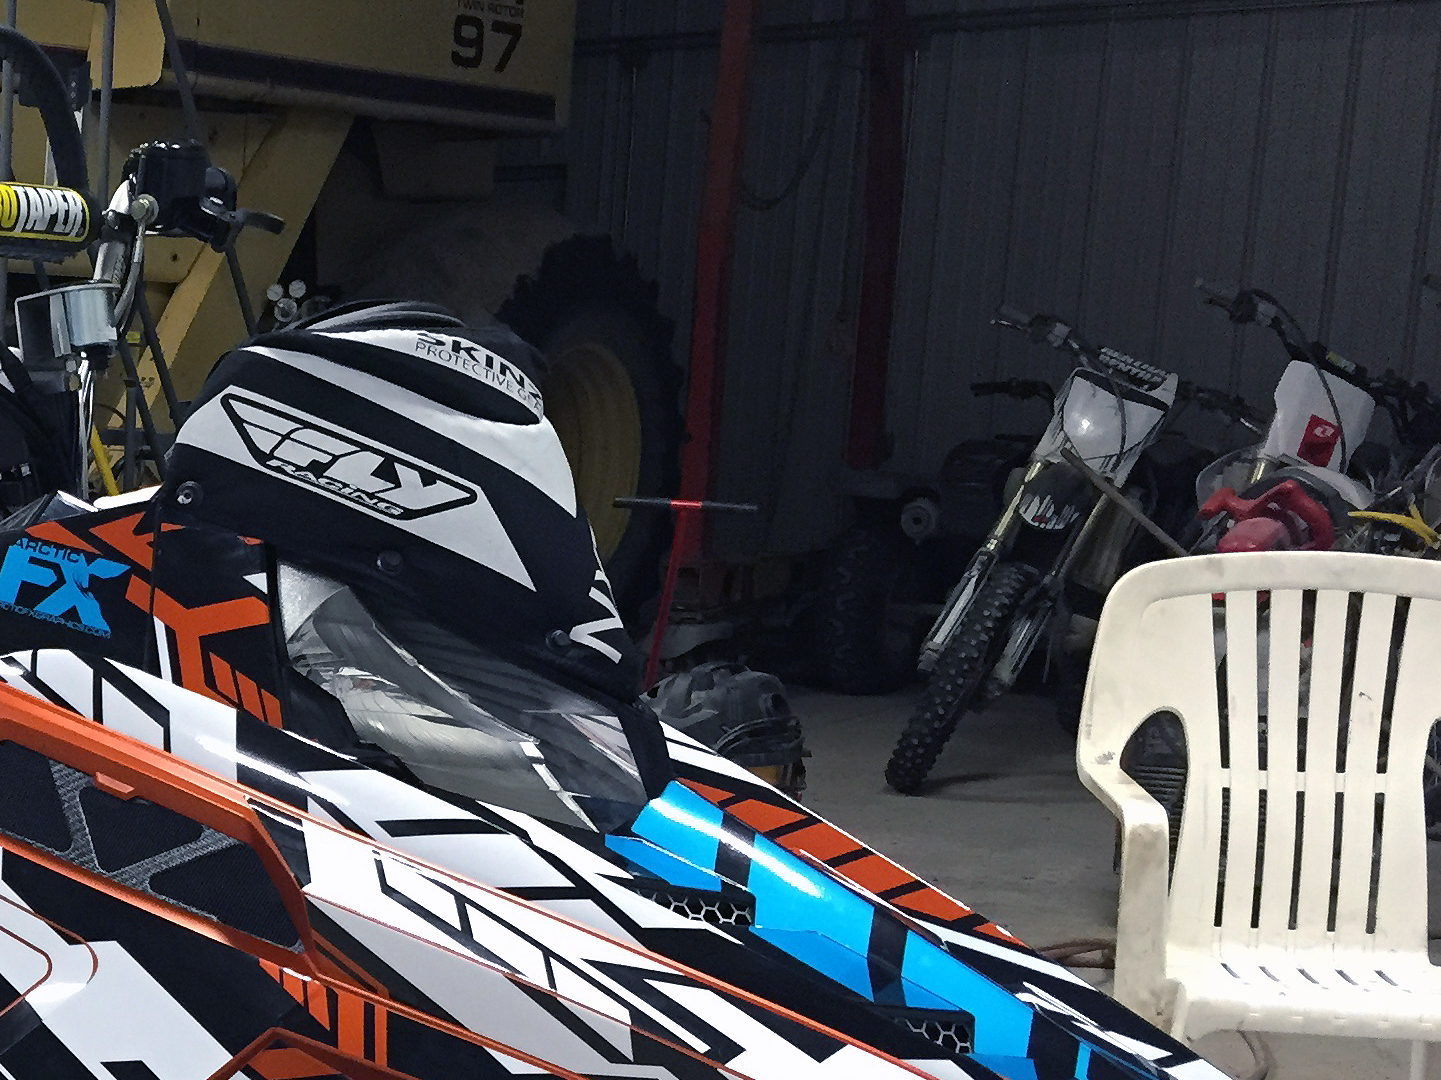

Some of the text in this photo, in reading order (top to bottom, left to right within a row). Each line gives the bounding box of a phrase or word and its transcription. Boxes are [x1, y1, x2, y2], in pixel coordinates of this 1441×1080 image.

[451, 13, 523, 73] 97
[416, 341, 514, 394] PROTECTIVE
[268, 427, 472, 511] FLY
[14, 538, 82, 563] ARCTIC
